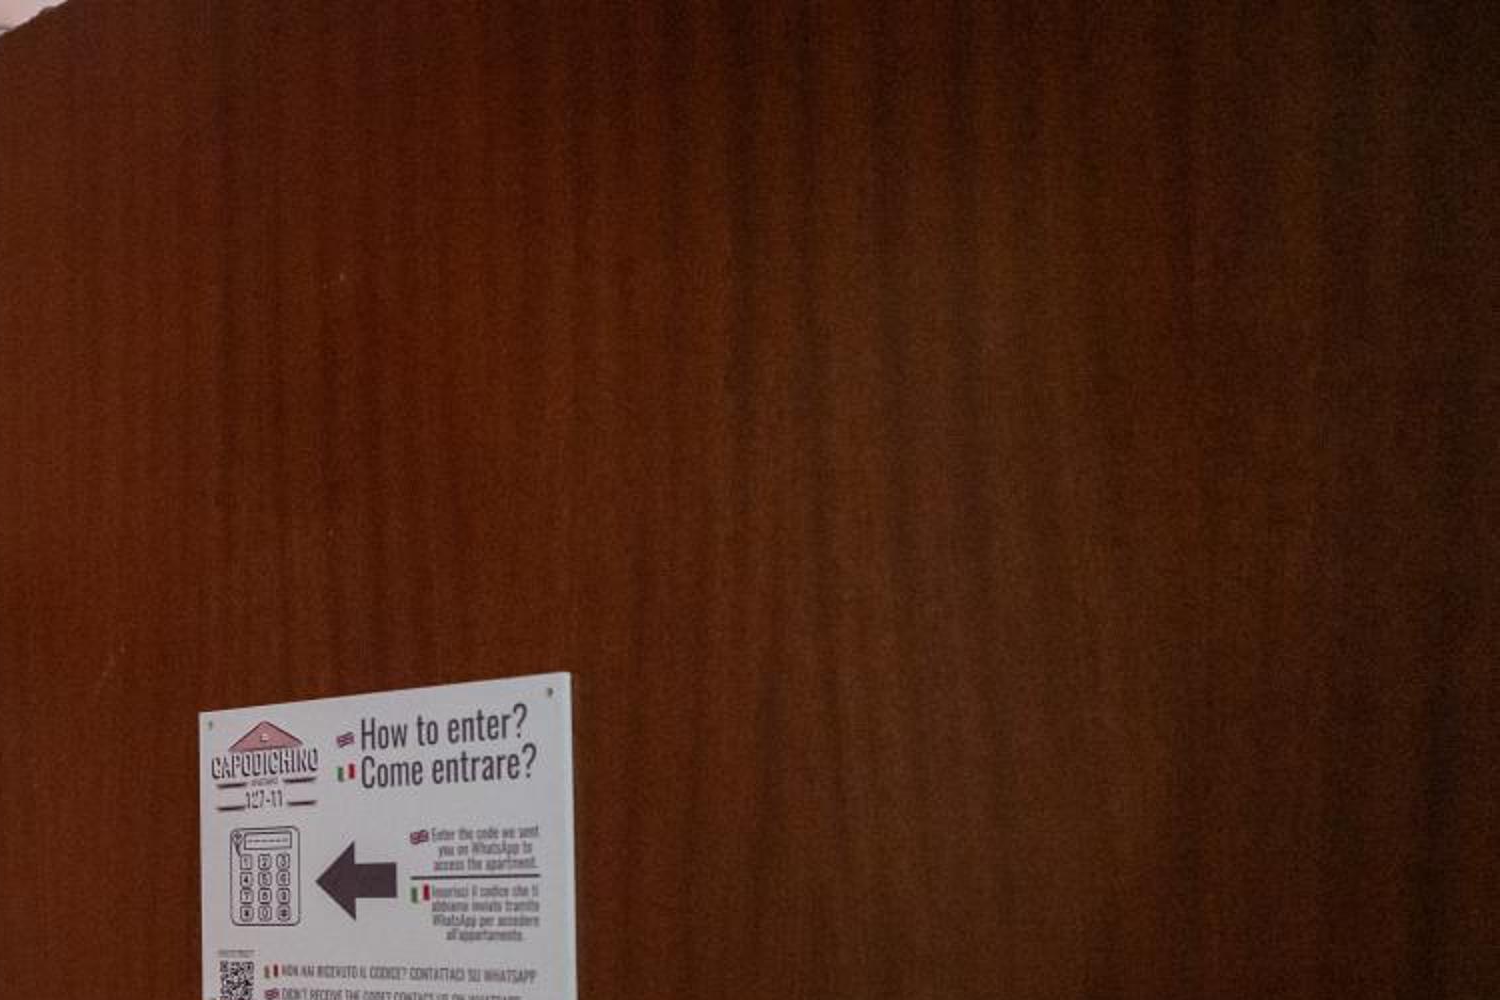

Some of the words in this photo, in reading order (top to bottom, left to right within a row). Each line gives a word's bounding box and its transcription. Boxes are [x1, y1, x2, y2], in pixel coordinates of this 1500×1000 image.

[361, 717, 408, 750] How
[417, 715, 439, 746] to
[448, 703, 528, 743] enter?
[212, 748, 318, 779] CAPODICHINO
[361, 756, 423, 788] Come
[432, 743, 537, 784] entrare?
[432, 827, 455, 841] Enter
[458, 827, 473, 840] the
[476, 826, 499, 839] code
[502, 829, 515, 838] we
[518, 825, 539, 838] sent
[438, 845, 454, 857] you
[457, 845, 468, 855] on
[471, 841, 520, 857] WhatsApp
[523, 841, 533, 853] to
[433, 861, 464, 870] access
[467, 858, 482, 870] the
[485, 857, 537, 870] apartment.
[431, 884, 468, 897] Inserisci
[472, 885, 479, 897] il
[480, 886, 509, 897] codice
[512, 885, 529, 896] che
[531, 884, 539, 896] ti
[432, 901, 468, 912] abbiamo
[471, 901, 502, 912] inviato
[505, 901, 539, 912] tramite
[432, 914, 476, 928] WhatsApp
[479, 916, 495, 928] per
[498, 915, 539, 927] accedere
[281, 964, 299, 977] NON
[302, 965, 315, 977] HAI
[317, 965, 357, 978] RICEVUTO
[370, 966, 407, 980] CODICE?
[410, 967, 465, 981] CONTATTACI
[468, 968, 481, 982] SU
[484, 969, 537, 983] WHATSAPP
[281, 987, 307, 1000] DIDN'T
